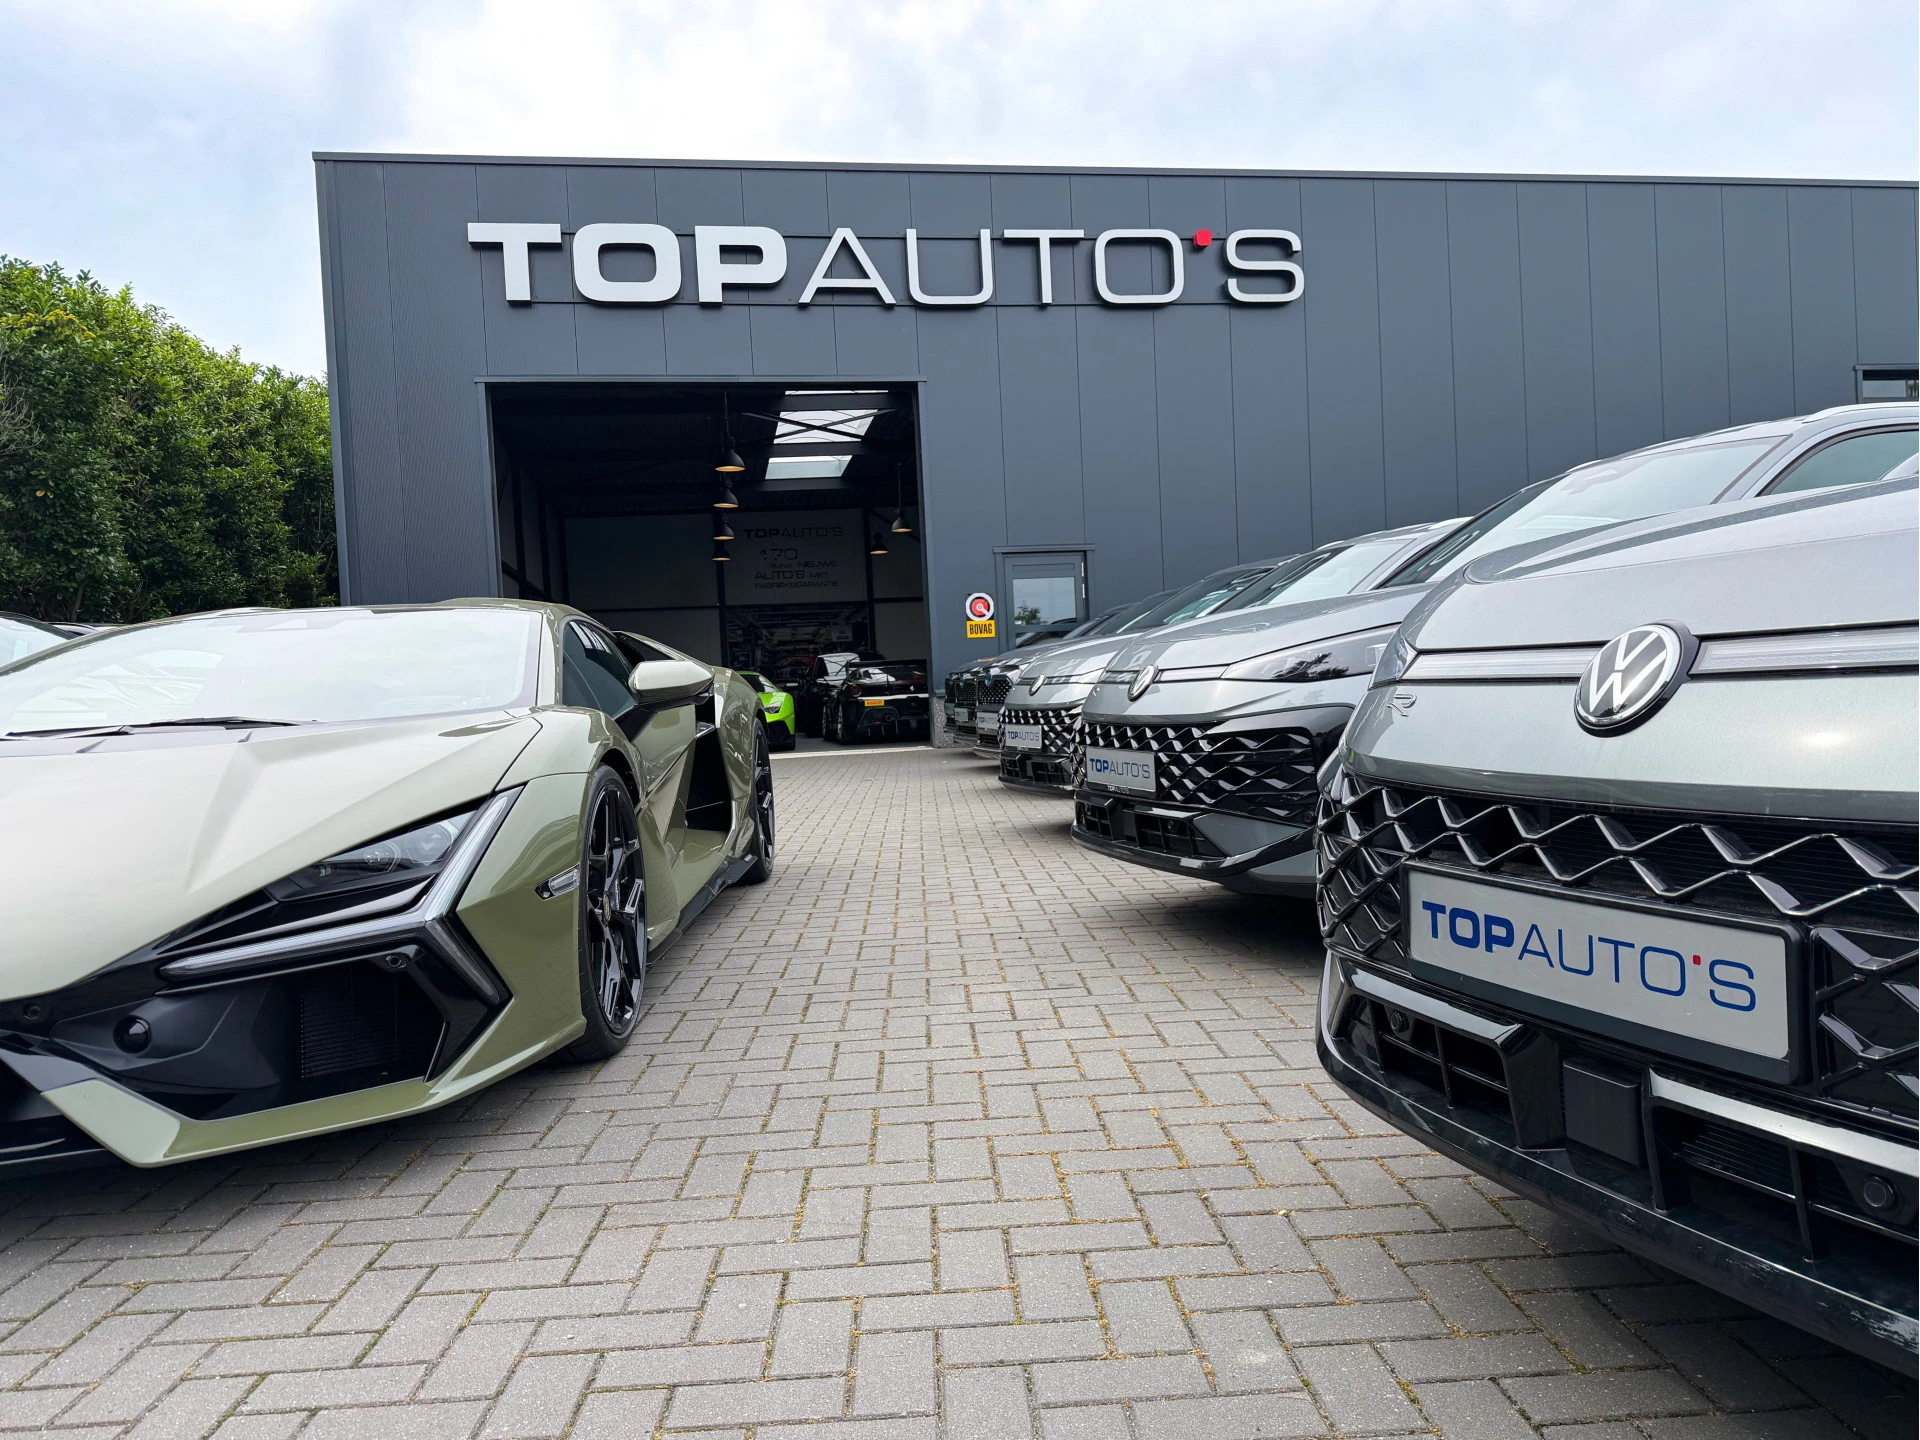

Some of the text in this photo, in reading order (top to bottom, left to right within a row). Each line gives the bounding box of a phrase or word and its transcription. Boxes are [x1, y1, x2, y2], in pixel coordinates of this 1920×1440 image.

[467, 221, 1306, 307] TOPAUTO'S
[743, 526, 844, 539] TOPAUTO'S
[759, 548, 798, 561] 170
[797, 560, 838, 568] NIEUWE
[754, 570, 805, 580] AUTO'S
[969, 623, 993, 635] BOVAG
[1007, 731, 1040, 742] TOPAUTO'S
[1089, 758, 1151, 779] TOPAUTO'S
[1421, 900, 1757, 1012] TOPAUTO'S
